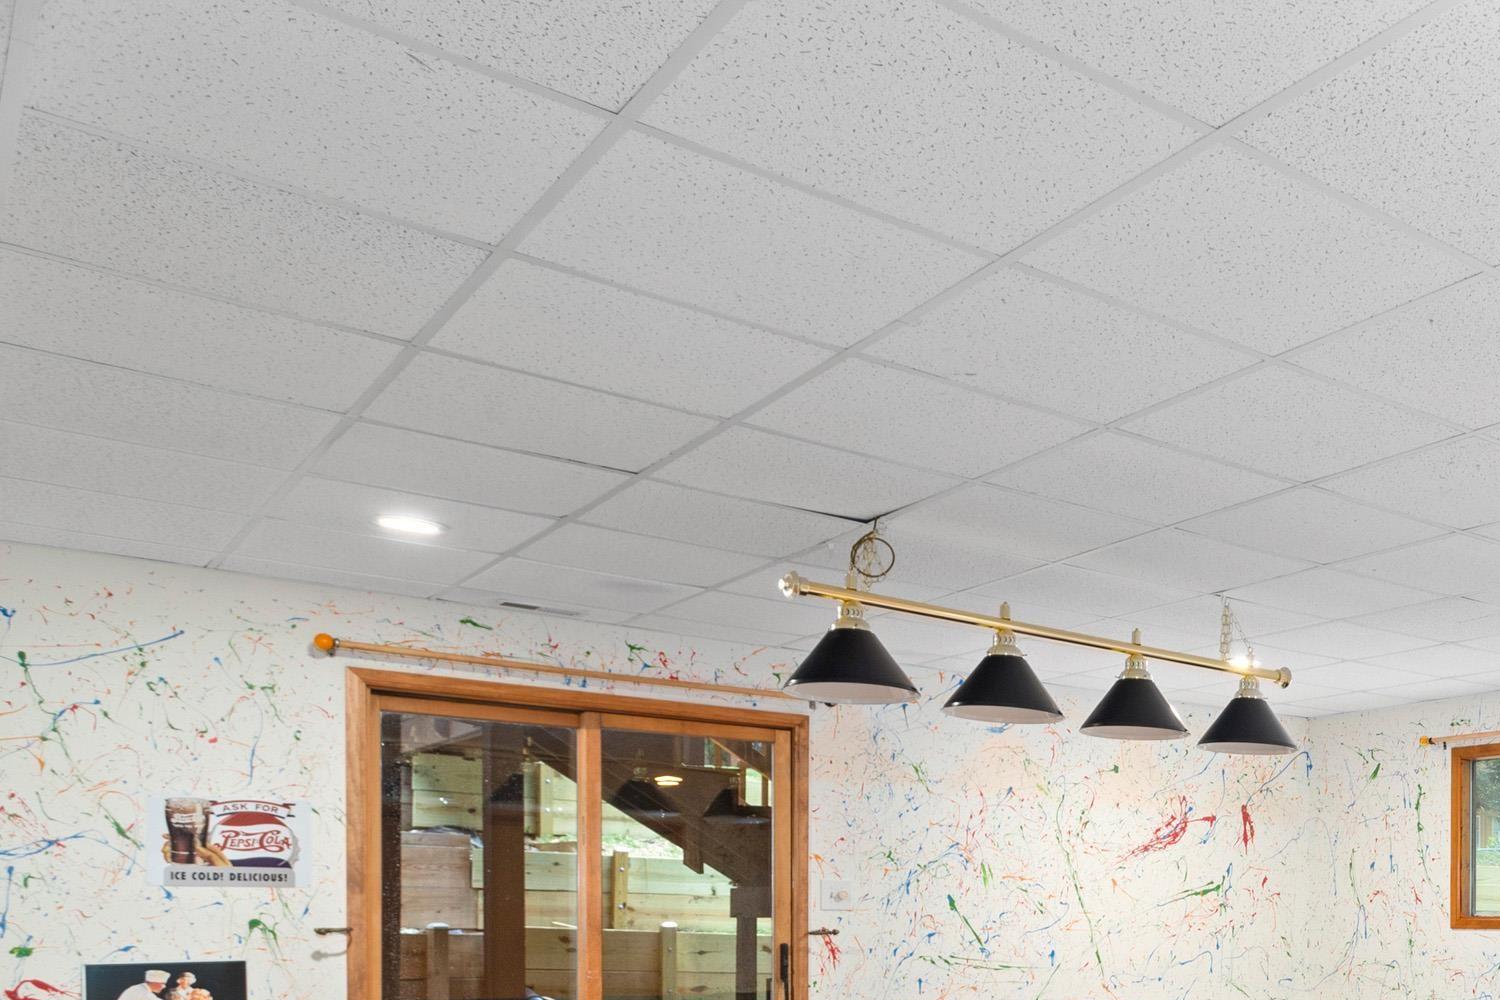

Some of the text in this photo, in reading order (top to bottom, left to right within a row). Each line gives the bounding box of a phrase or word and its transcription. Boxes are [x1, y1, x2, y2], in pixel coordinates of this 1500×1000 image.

[223, 804, 279, 813] ASK FOR
[170, 871, 288, 882] ICE COLD! DELICIOUS!
